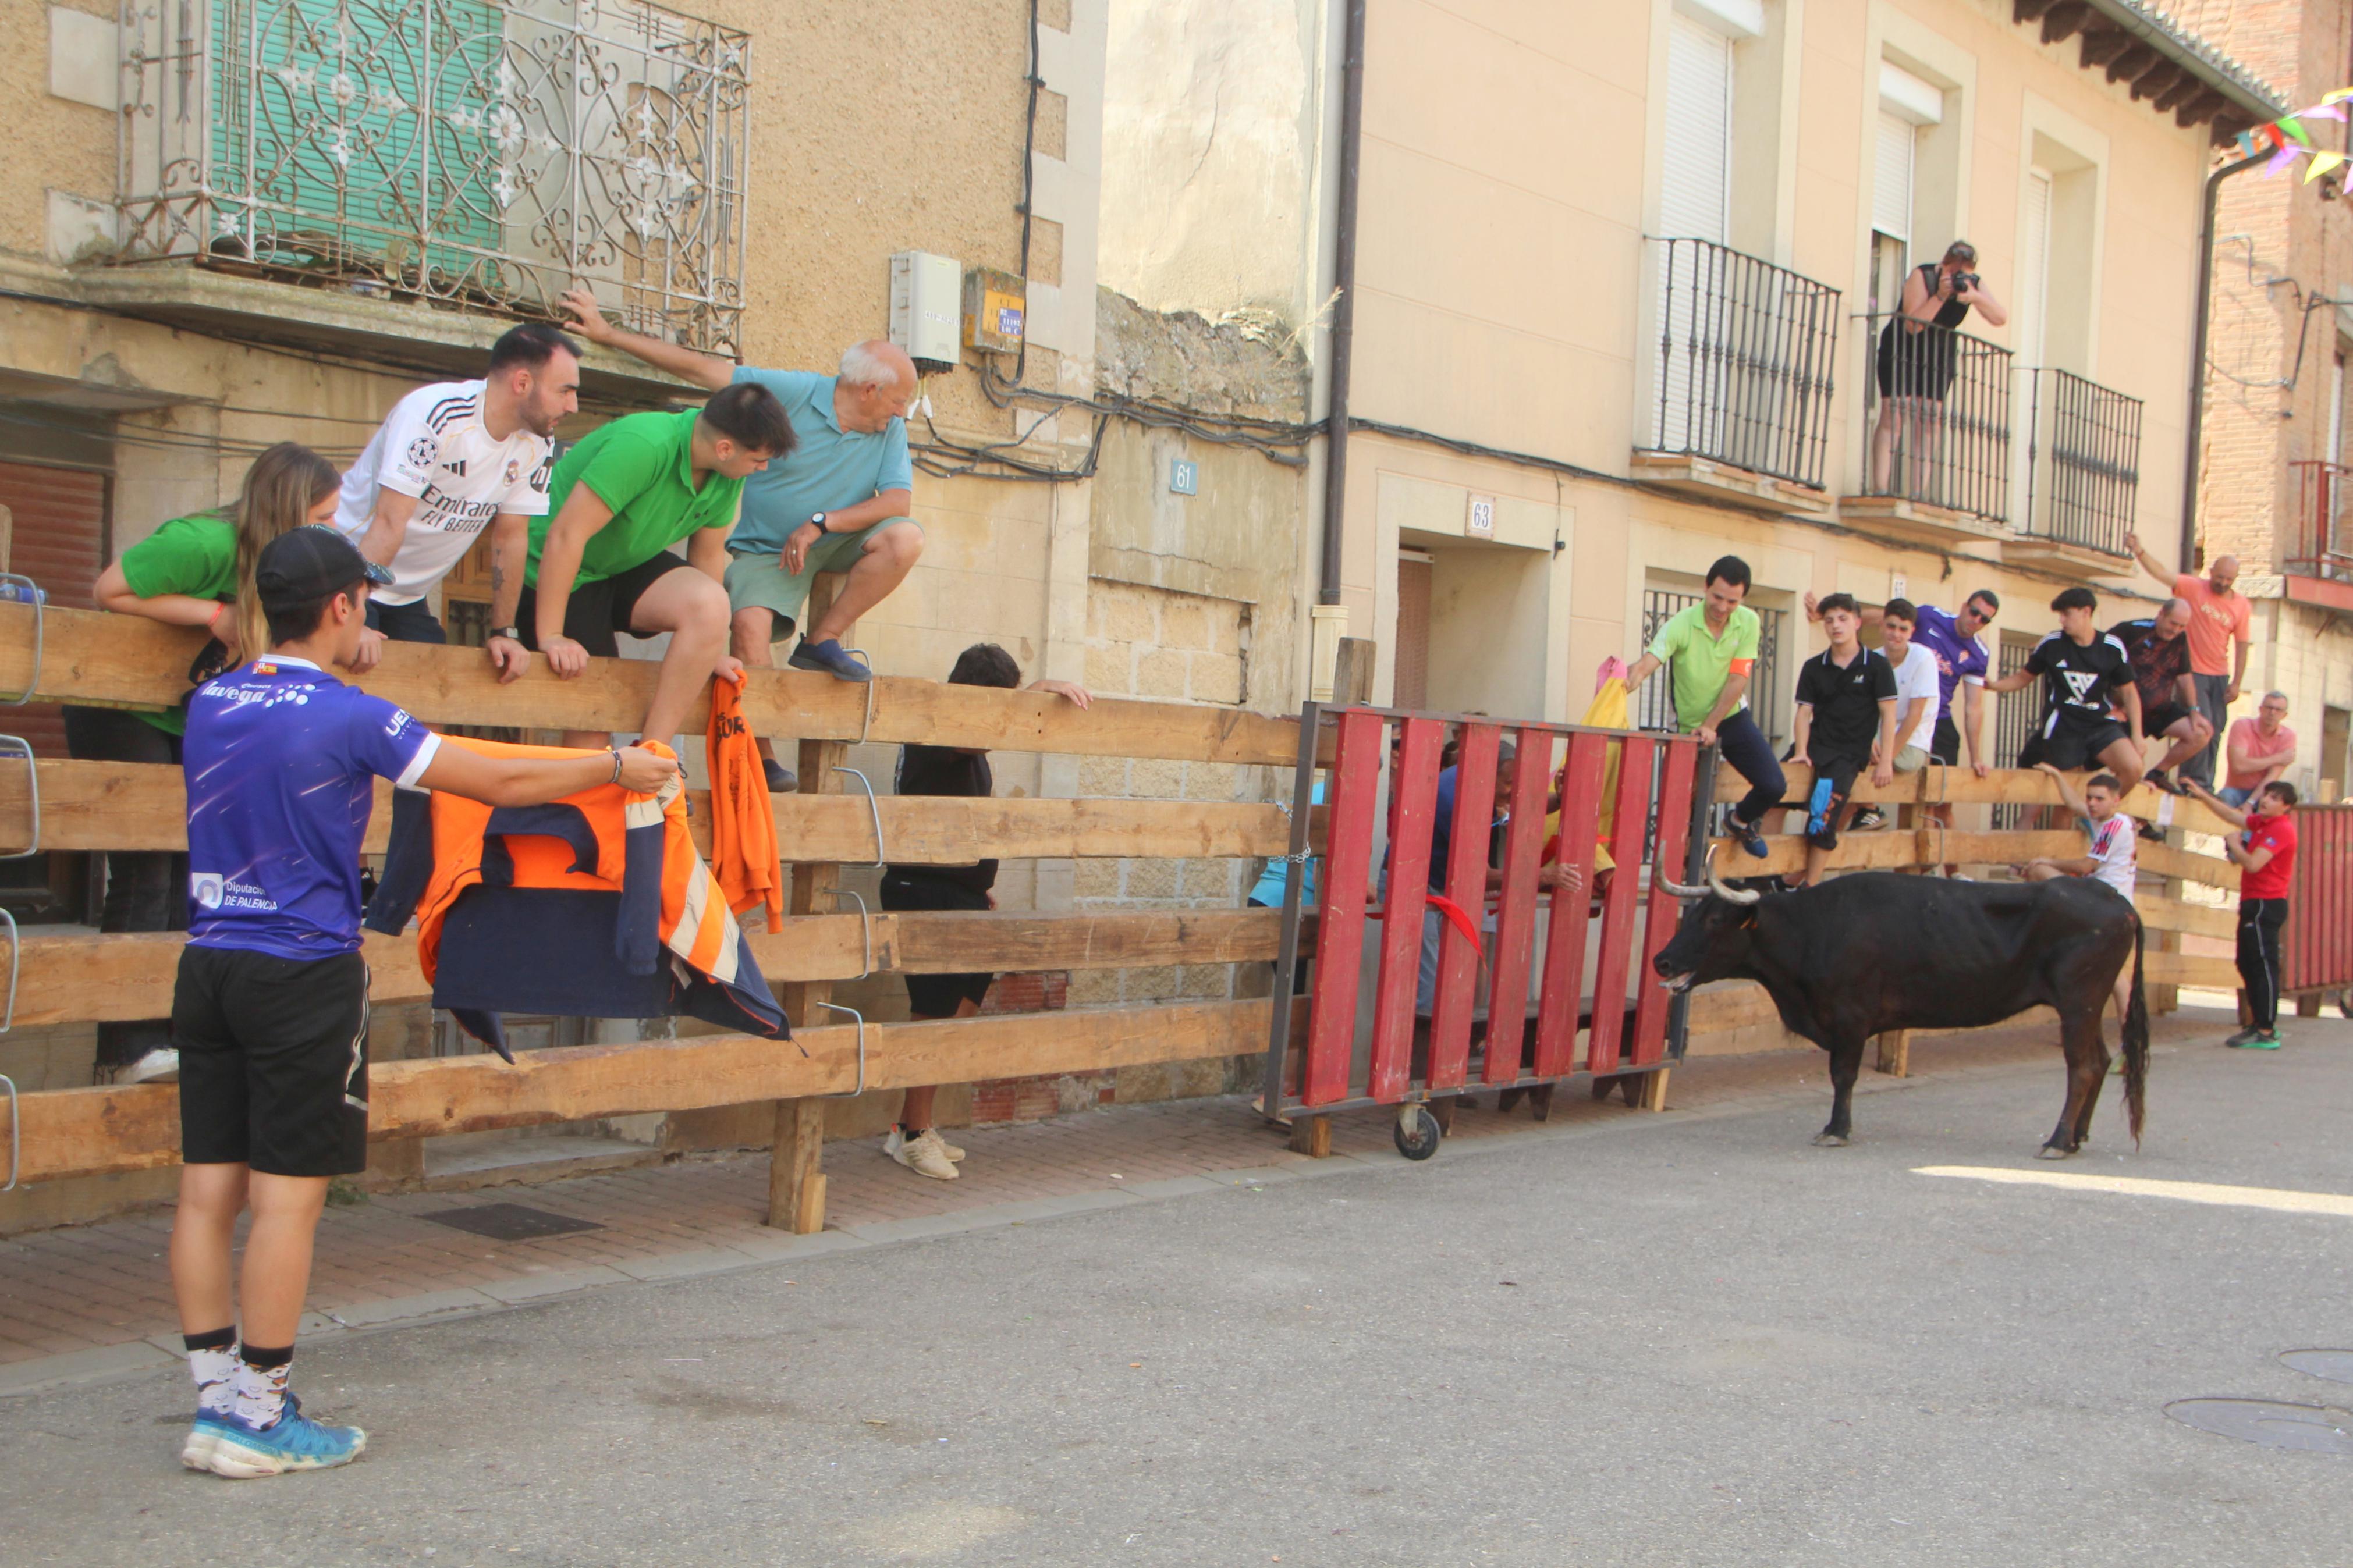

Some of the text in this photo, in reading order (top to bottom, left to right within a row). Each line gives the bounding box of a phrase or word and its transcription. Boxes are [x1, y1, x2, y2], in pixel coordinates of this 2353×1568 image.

[1177, 464, 1190, 489] 61
[420, 483, 503, 517] Emirates
[421, 510, 485, 534] FLY BETTER
[1474, 503, 1489, 528] 63
[224, 895, 279, 911] DE PALENCIA
